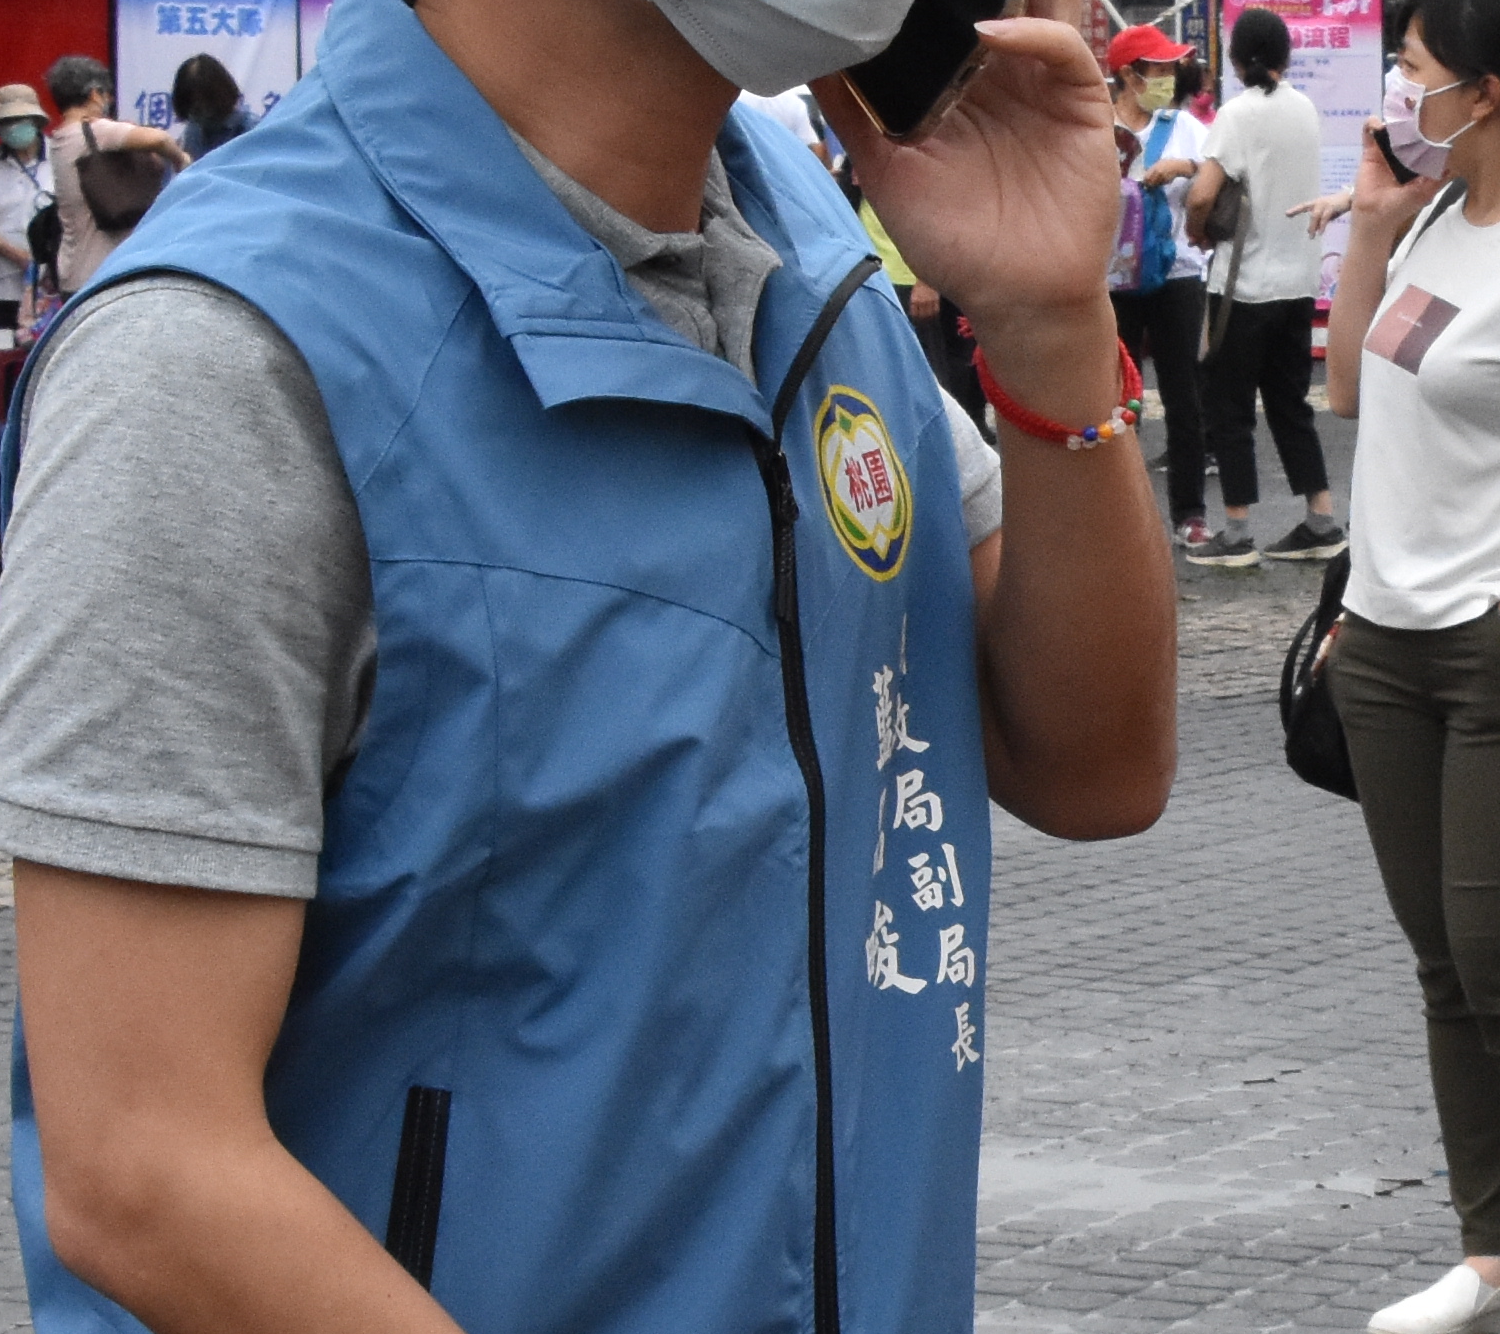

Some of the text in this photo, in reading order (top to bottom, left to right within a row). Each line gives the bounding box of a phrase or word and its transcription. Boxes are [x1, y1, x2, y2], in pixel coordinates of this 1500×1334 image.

[156, 4, 264, 38] 第五大隊
[844, 447, 895, 514] 桃園
